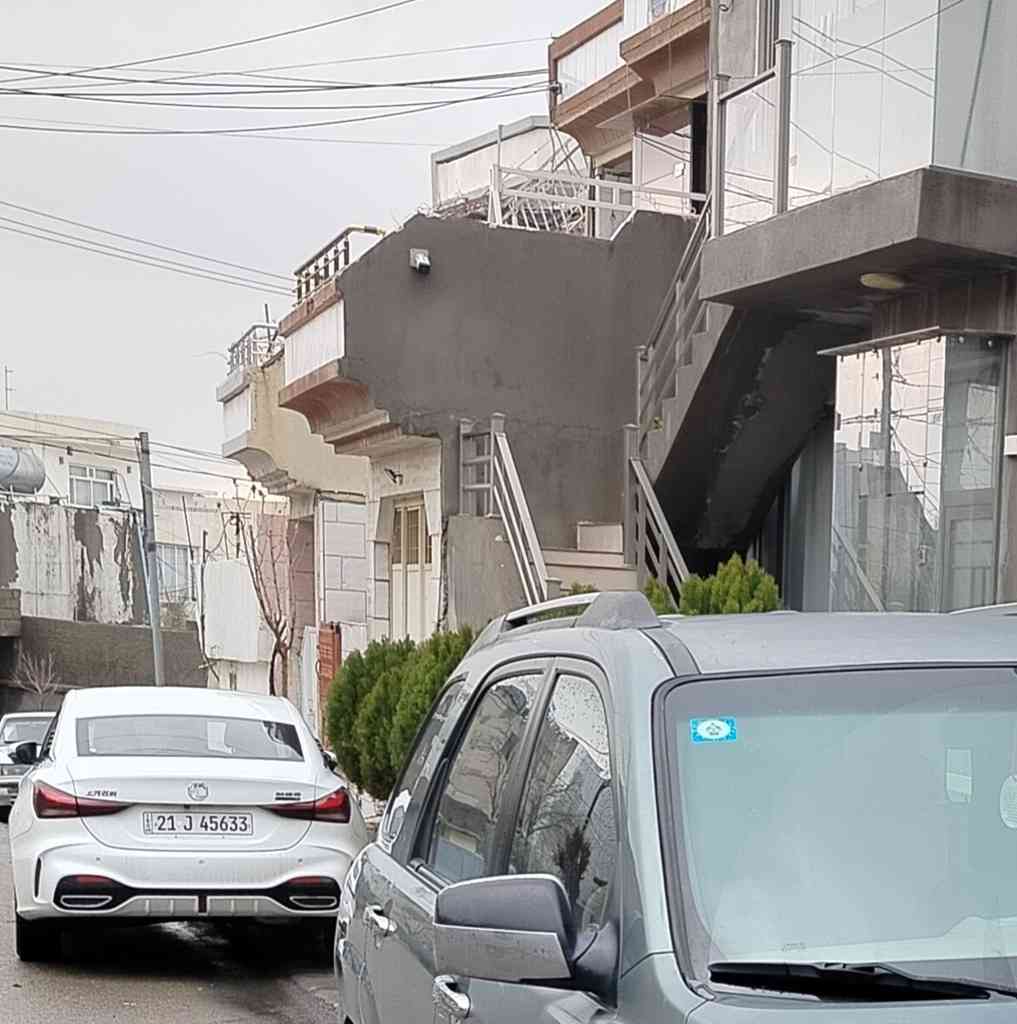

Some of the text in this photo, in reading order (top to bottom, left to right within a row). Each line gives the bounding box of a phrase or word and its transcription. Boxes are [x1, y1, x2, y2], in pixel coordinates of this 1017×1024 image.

[157, 815, 176, 831] 21
[183, 815, 193, 831] J
[200, 815, 248, 832] 45633
